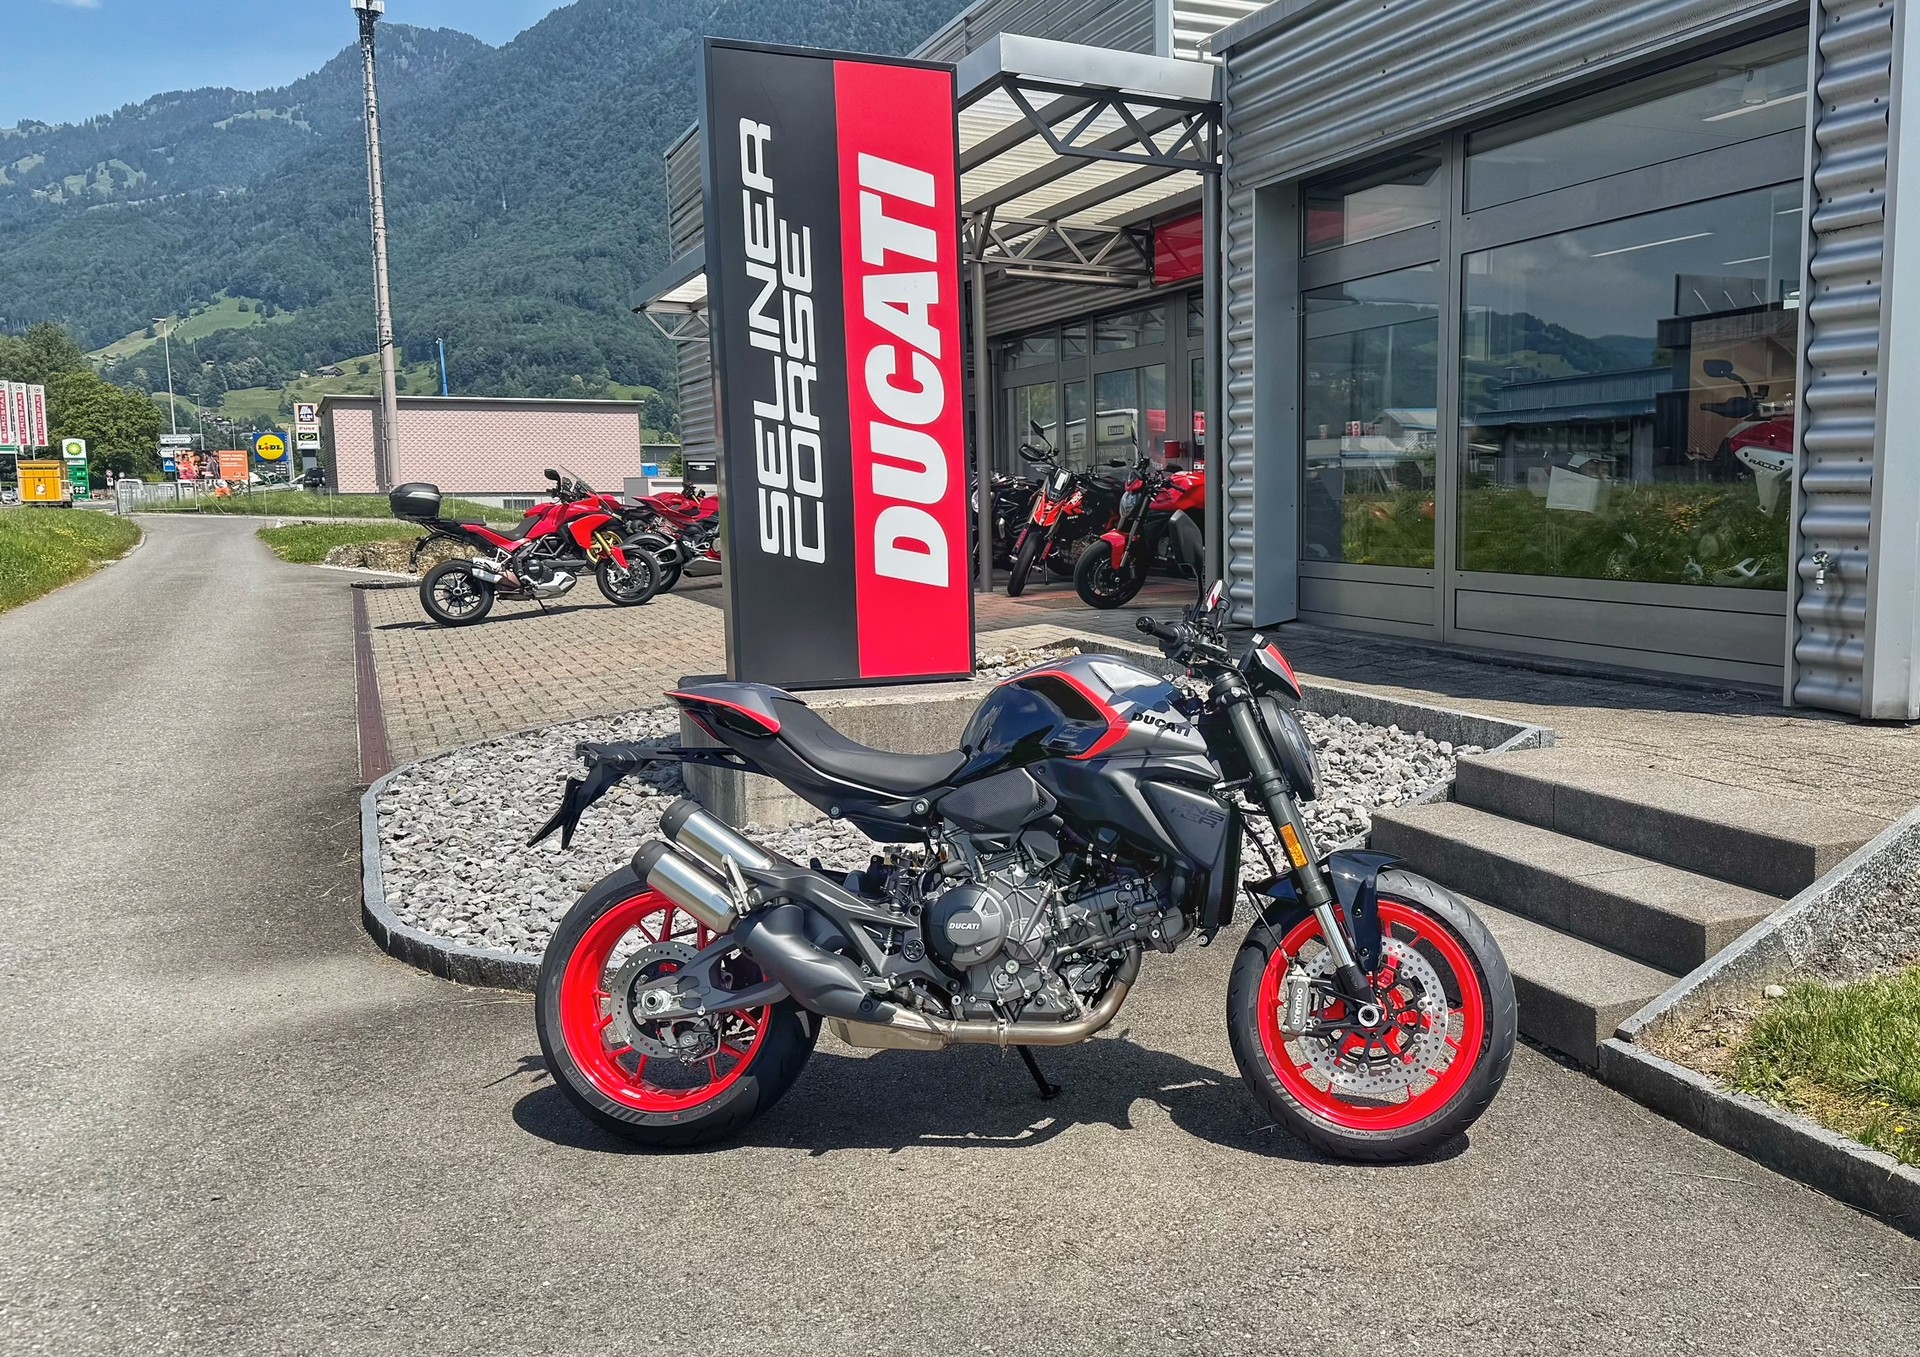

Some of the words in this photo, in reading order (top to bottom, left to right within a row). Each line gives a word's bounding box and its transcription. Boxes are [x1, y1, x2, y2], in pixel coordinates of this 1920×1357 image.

[739, 117, 792, 558] SELINER
[780, 218, 826, 565] CORSE
[857, 152, 948, 588] DUCATI
[17, 393, 26, 440] EUROSPAR
[35, 395, 44, 440] EUROSPAR
[1131, 712, 1190, 738] DUCATI
[948, 922, 980, 931] DUCATI
[1291, 987, 1304, 1026] brembo
